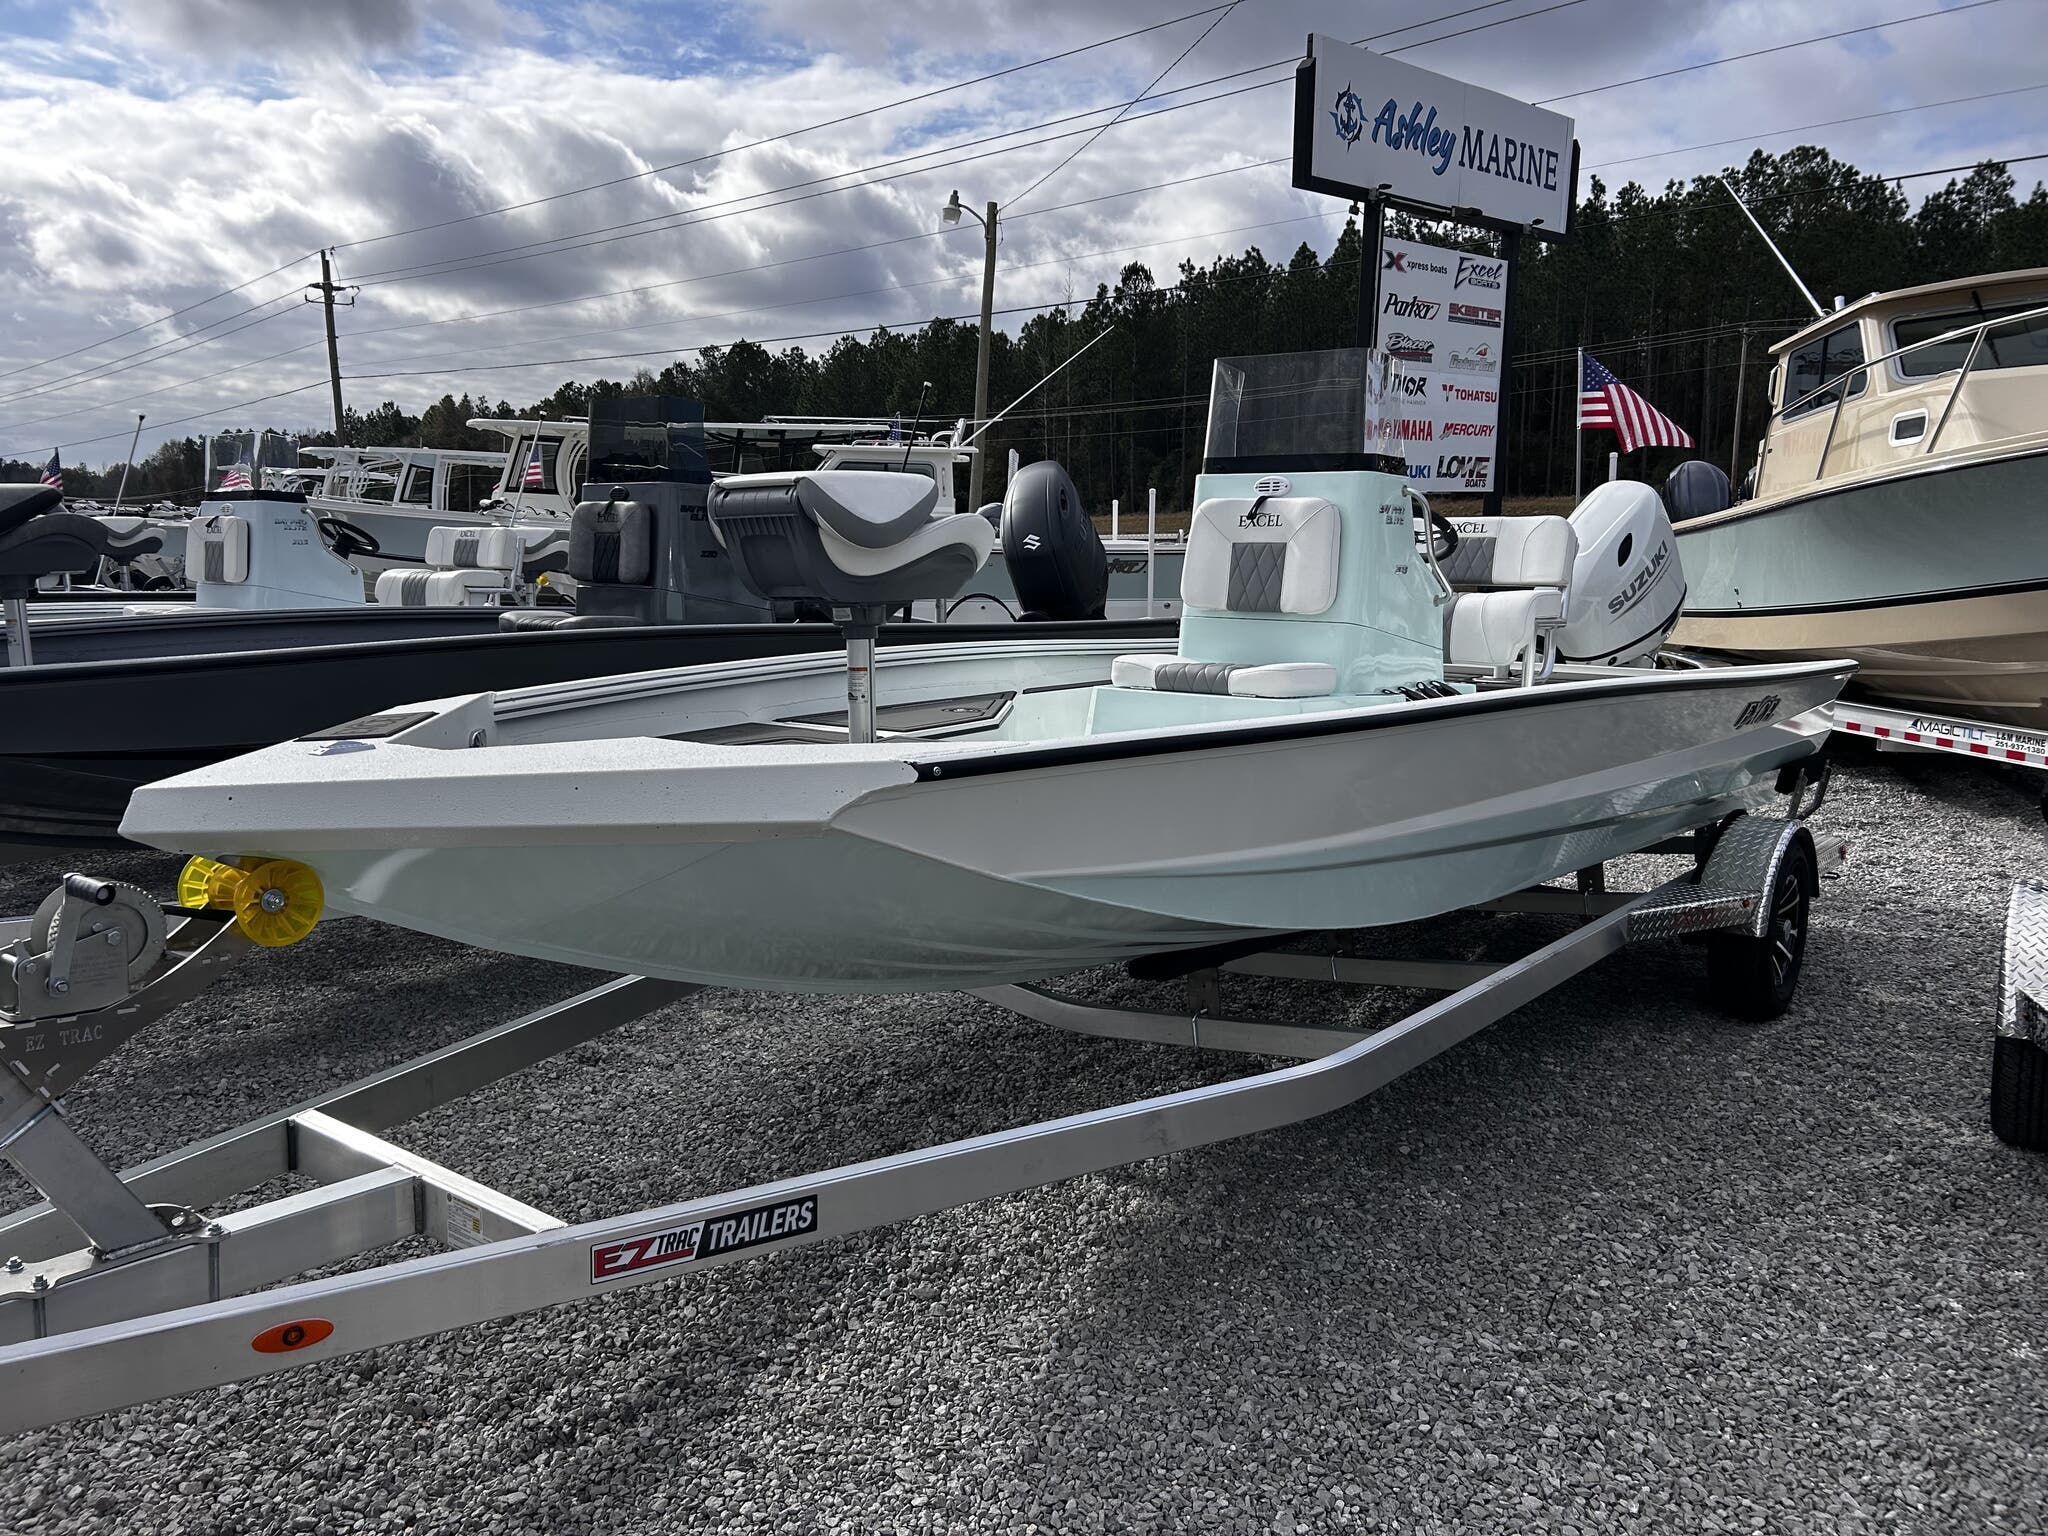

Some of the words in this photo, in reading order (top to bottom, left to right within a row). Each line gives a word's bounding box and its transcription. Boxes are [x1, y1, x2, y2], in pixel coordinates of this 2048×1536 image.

[1371, 98, 1457, 176] Ashley
[1458, 125, 1559, 192] MARINE
[1406, 260, 1430, 272] xpress
[1430, 262, 1448, 275] boats
[1454, 256, 1503, 290] Excel
[1383, 293, 1436, 320] Parker
[1385, 333, 1435, 353] Blazer
[1391, 373, 1427, 398] THOR
[1455, 388, 1498, 403] TOHATSU
[1392, 418, 1433, 441] YAMAHA
[1441, 422, 1496, 439] MERCURY
[1436, 455, 1491, 479] LOWE
[1465, 479, 1487, 488] BOATS
[1452, 521, 1488, 534] XCEL
[1608, 539, 1668, 615] SUZUKI
[1920, 720, 1987, 741] MAGICTILT
[1996, 731, 2014, 742] L&M
[2014, 734, 2047, 748] MARINE
[1995, 740, 2046, 755] 251-937-1380
[25, 1034, 45, 1052] EZ
[59, 1024, 103, 1046] TRAC
[594, 1236, 682, 1278] EZ
[655, 1227, 700, 1255] TRAC
[709, 1200, 815, 1251] TRAILERS
